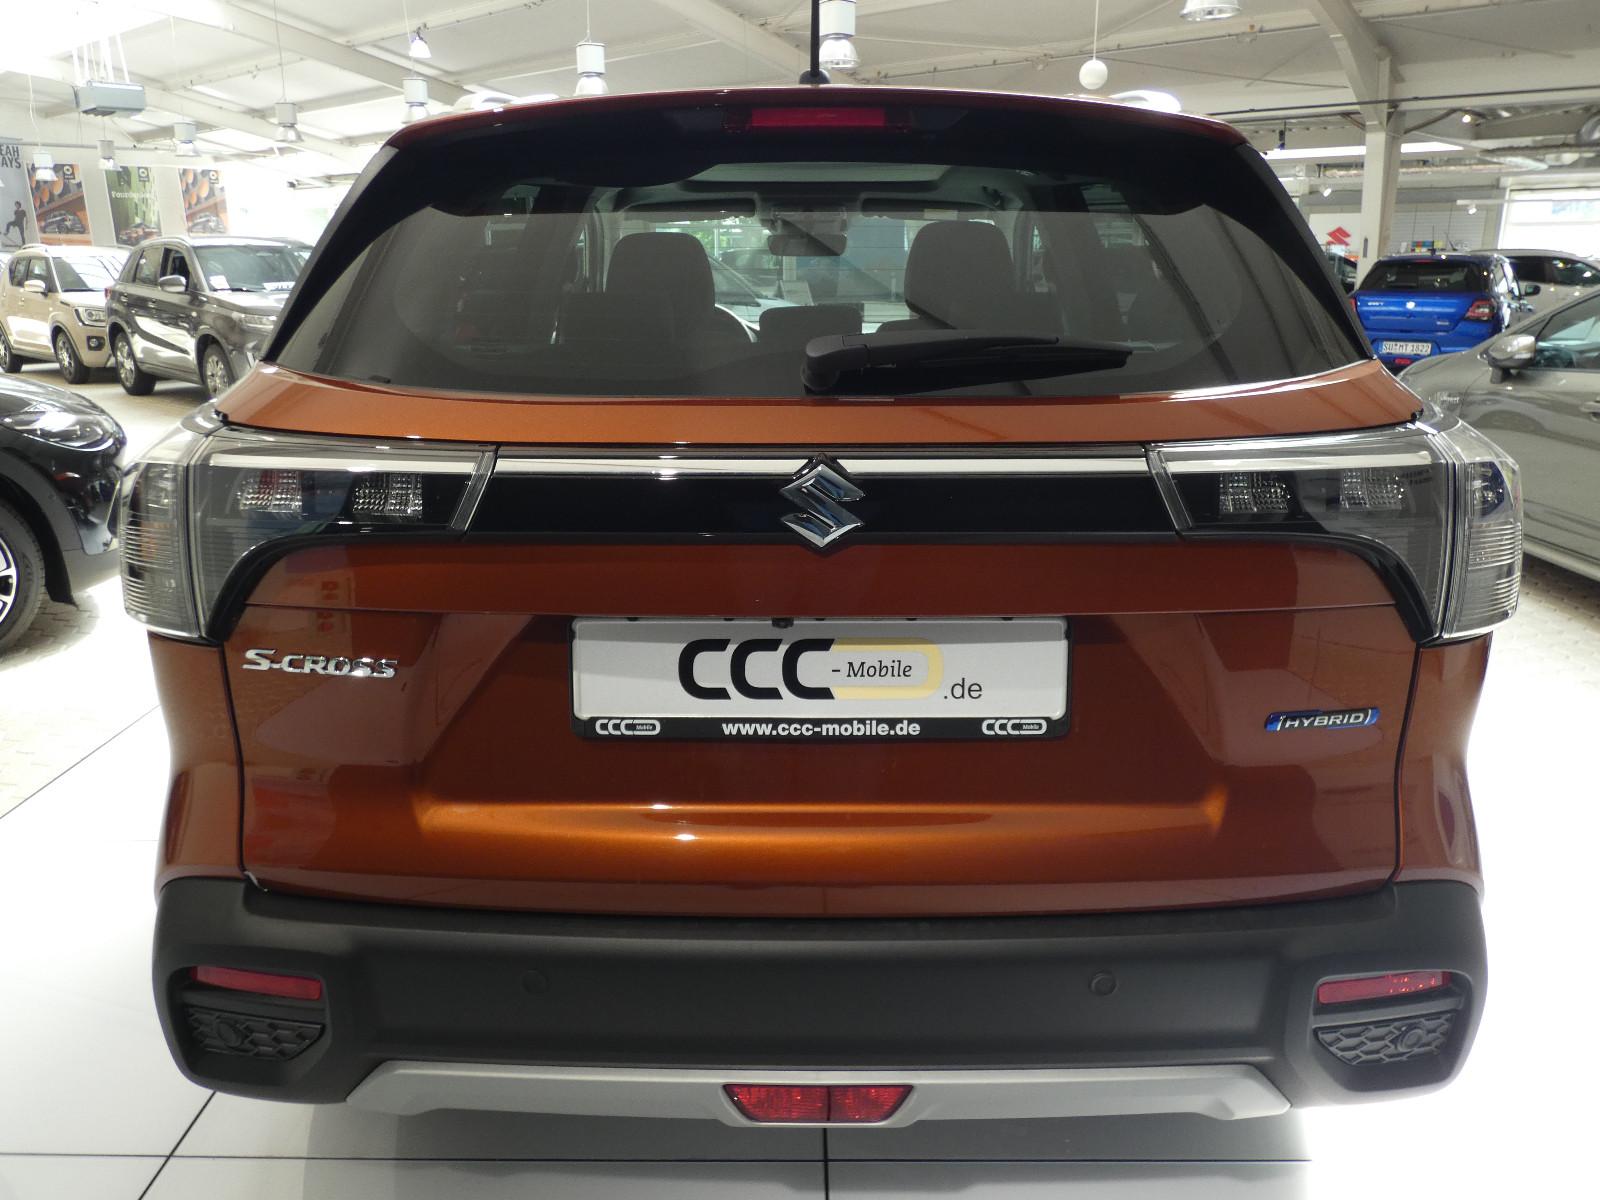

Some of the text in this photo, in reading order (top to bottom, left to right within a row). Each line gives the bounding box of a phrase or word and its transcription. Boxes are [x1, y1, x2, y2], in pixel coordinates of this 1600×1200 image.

[241, 648, 398, 679] S-CROSS
[721, 719, 921, 736] www.ccc-mobile.de
[1284, 712, 1365, 728] HYBRID
